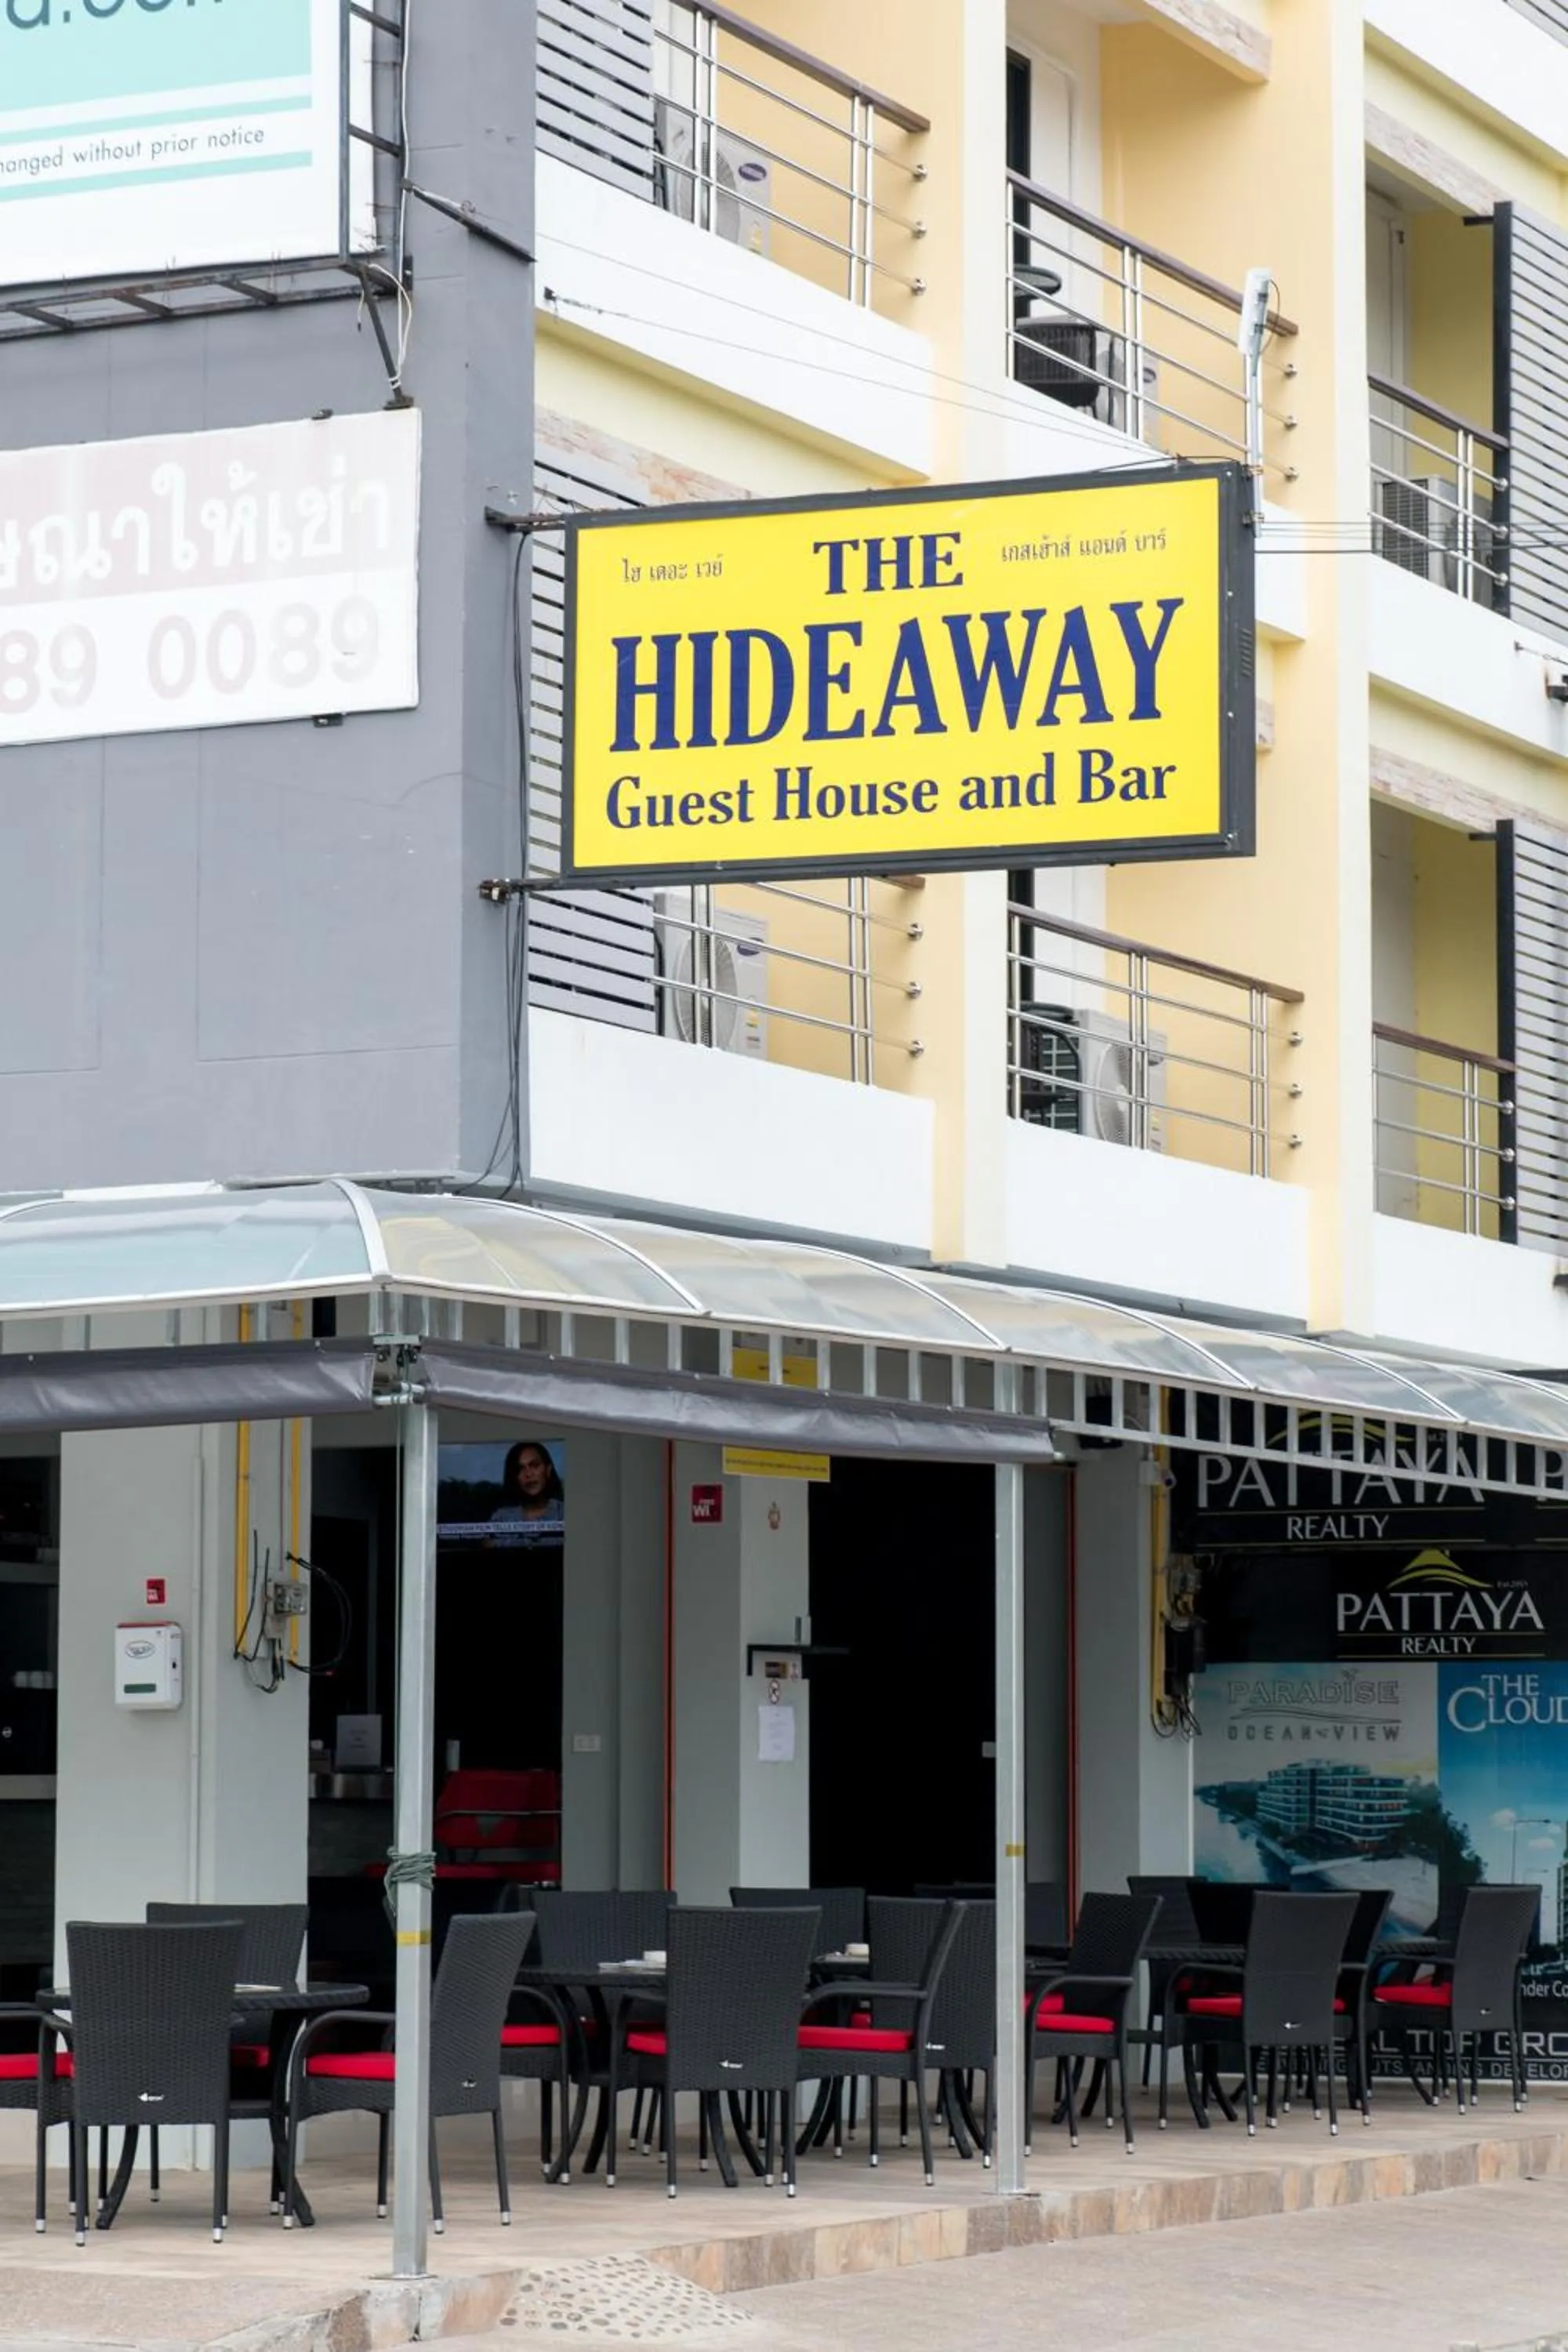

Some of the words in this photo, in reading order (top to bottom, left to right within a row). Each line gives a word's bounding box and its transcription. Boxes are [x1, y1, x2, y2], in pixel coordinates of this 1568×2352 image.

[72, 138, 142, 163] without
[151, 133, 198, 160] prior
[208, 125, 264, 148] notice
[813, 532, 964, 595] THE
[147, 595, 379, 699] 0089
[609, 597, 1185, 752] HIDEAWAY
[607, 775, 754, 829] Guest
[774, 766, 938, 821] House
[960, 752, 1056, 811] and
[1077, 748, 1178, 804] Bar
[1287, 1514, 1390, 1540] REALTY
[1336, 1591, 1545, 1632] PATTAYA
[1401, 1637, 1476, 1654] REALTY
[1228, 1679, 1400, 1704] PARADISE
[1480, 1674, 1541, 1696] THE
[1446, 1686, 1568, 1733] CLOUD
[1228, 1725, 1311, 1740] OCEAN
[1334, 1725, 1401, 1741] VIEW
[1519, 1979, 1550, 1998] nder
[1490, 2063, 1568, 2079] DEELO
